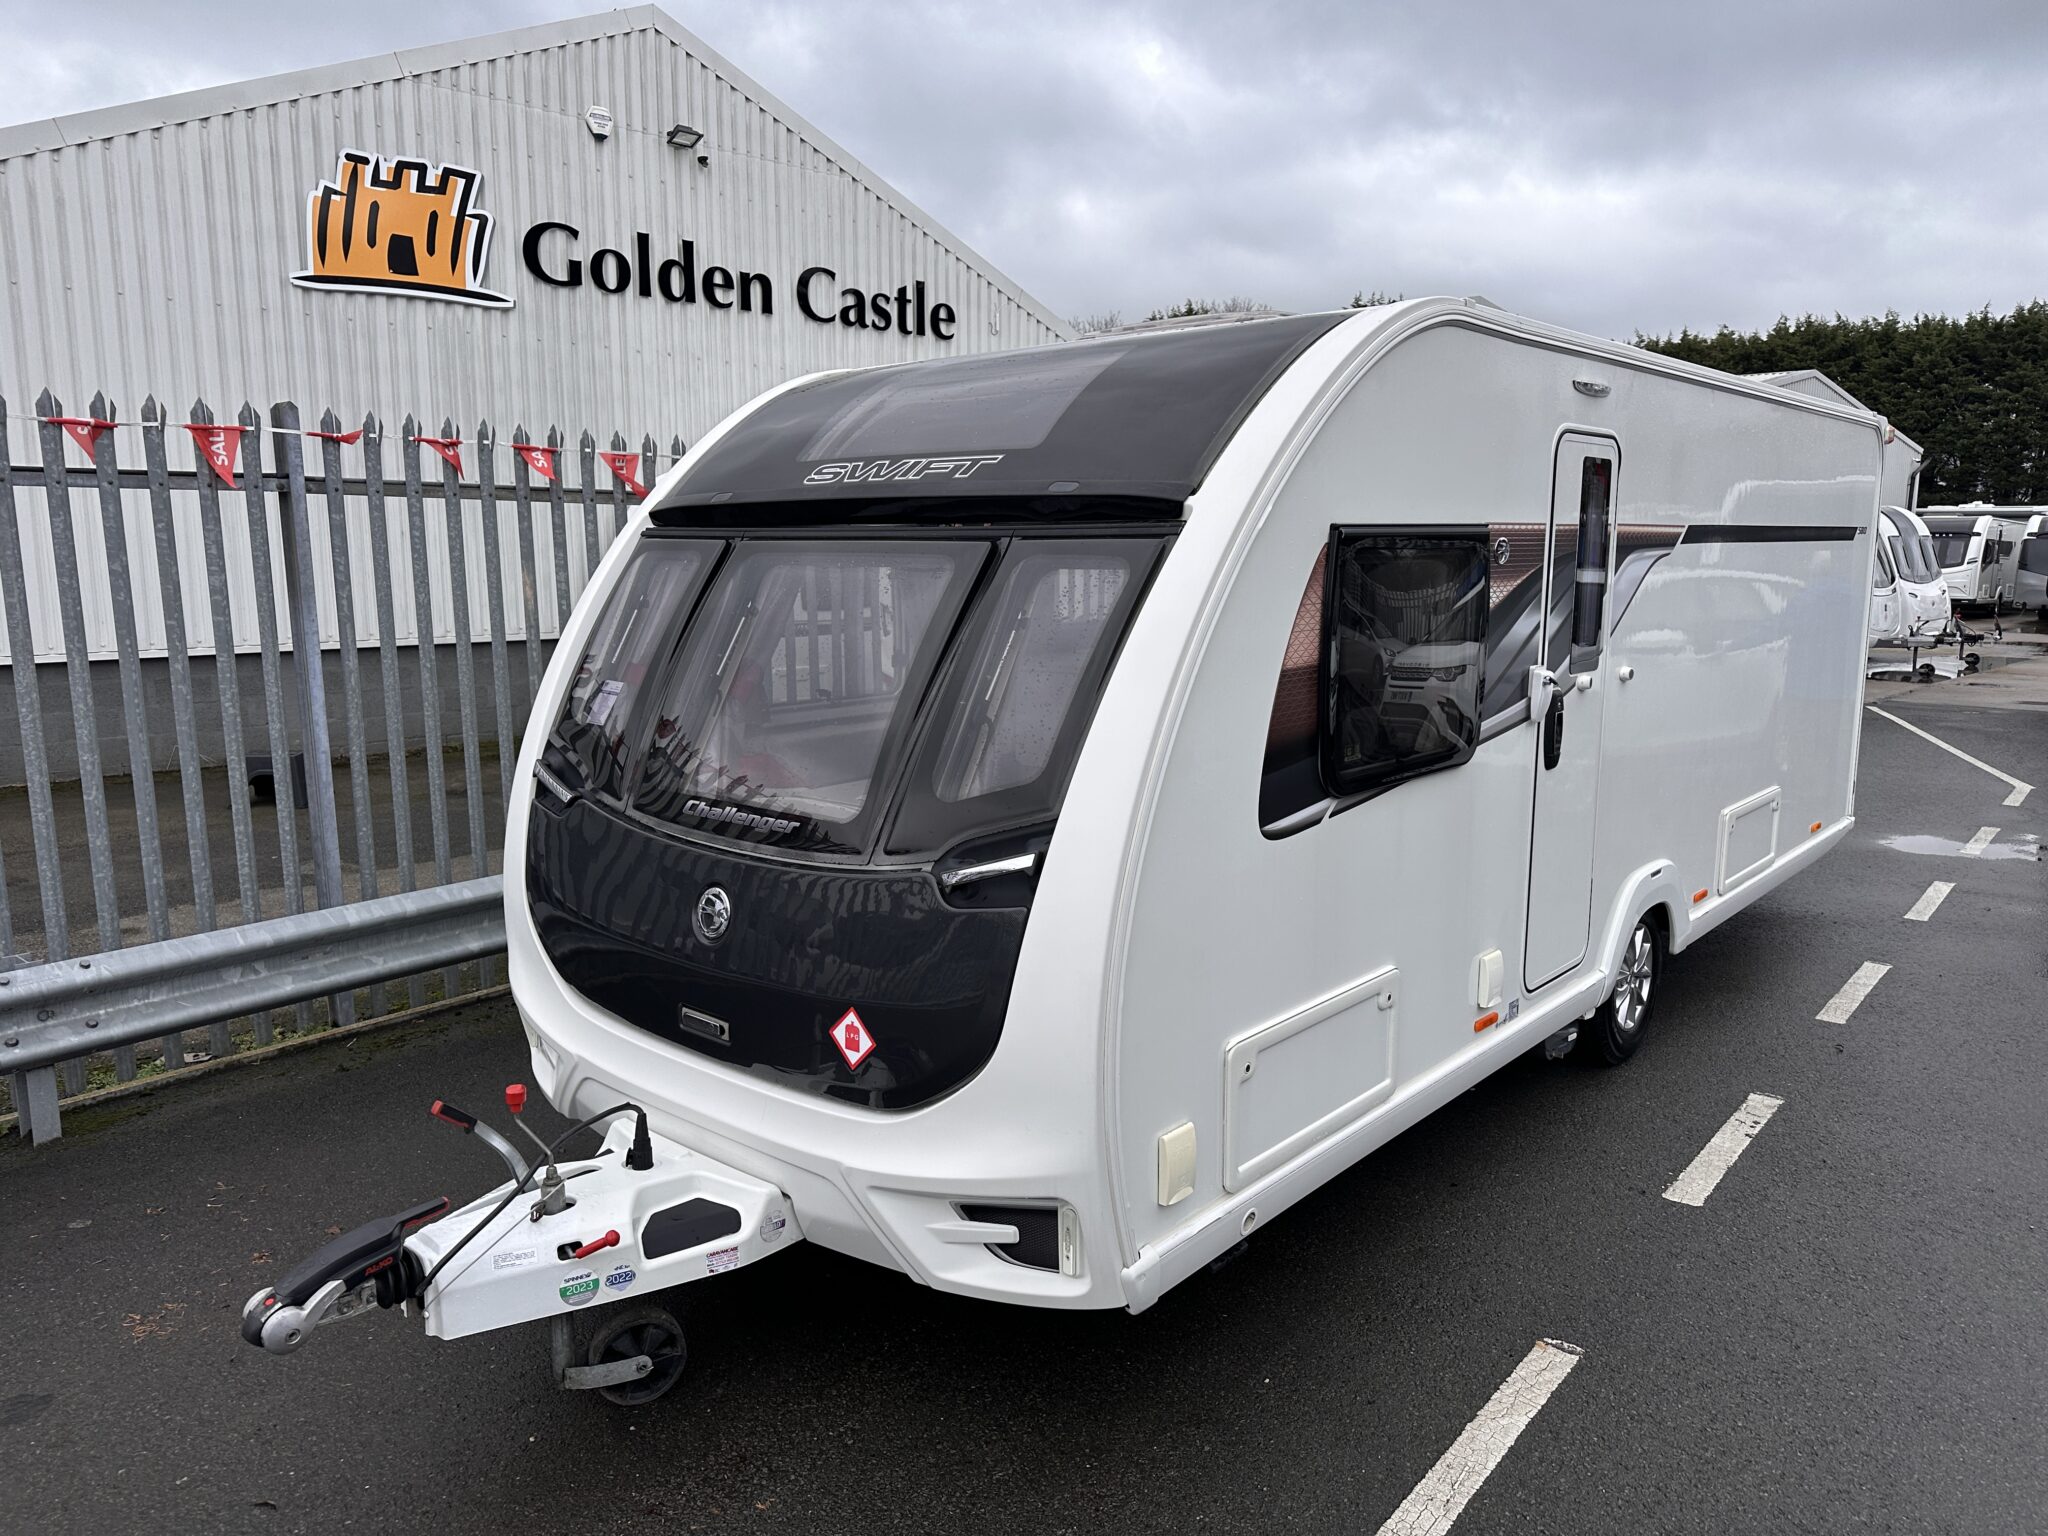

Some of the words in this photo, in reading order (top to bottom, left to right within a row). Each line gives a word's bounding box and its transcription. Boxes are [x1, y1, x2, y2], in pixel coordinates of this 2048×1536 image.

[522, 221, 773, 315] Golden
[796, 266, 956, 340] Castle
[803, 454, 1006, 484] SWIFT
[682, 799, 801, 834] Challenger
[566, 1280, 594, 1296] 2023
[606, 1271, 632, 1286] 2022
